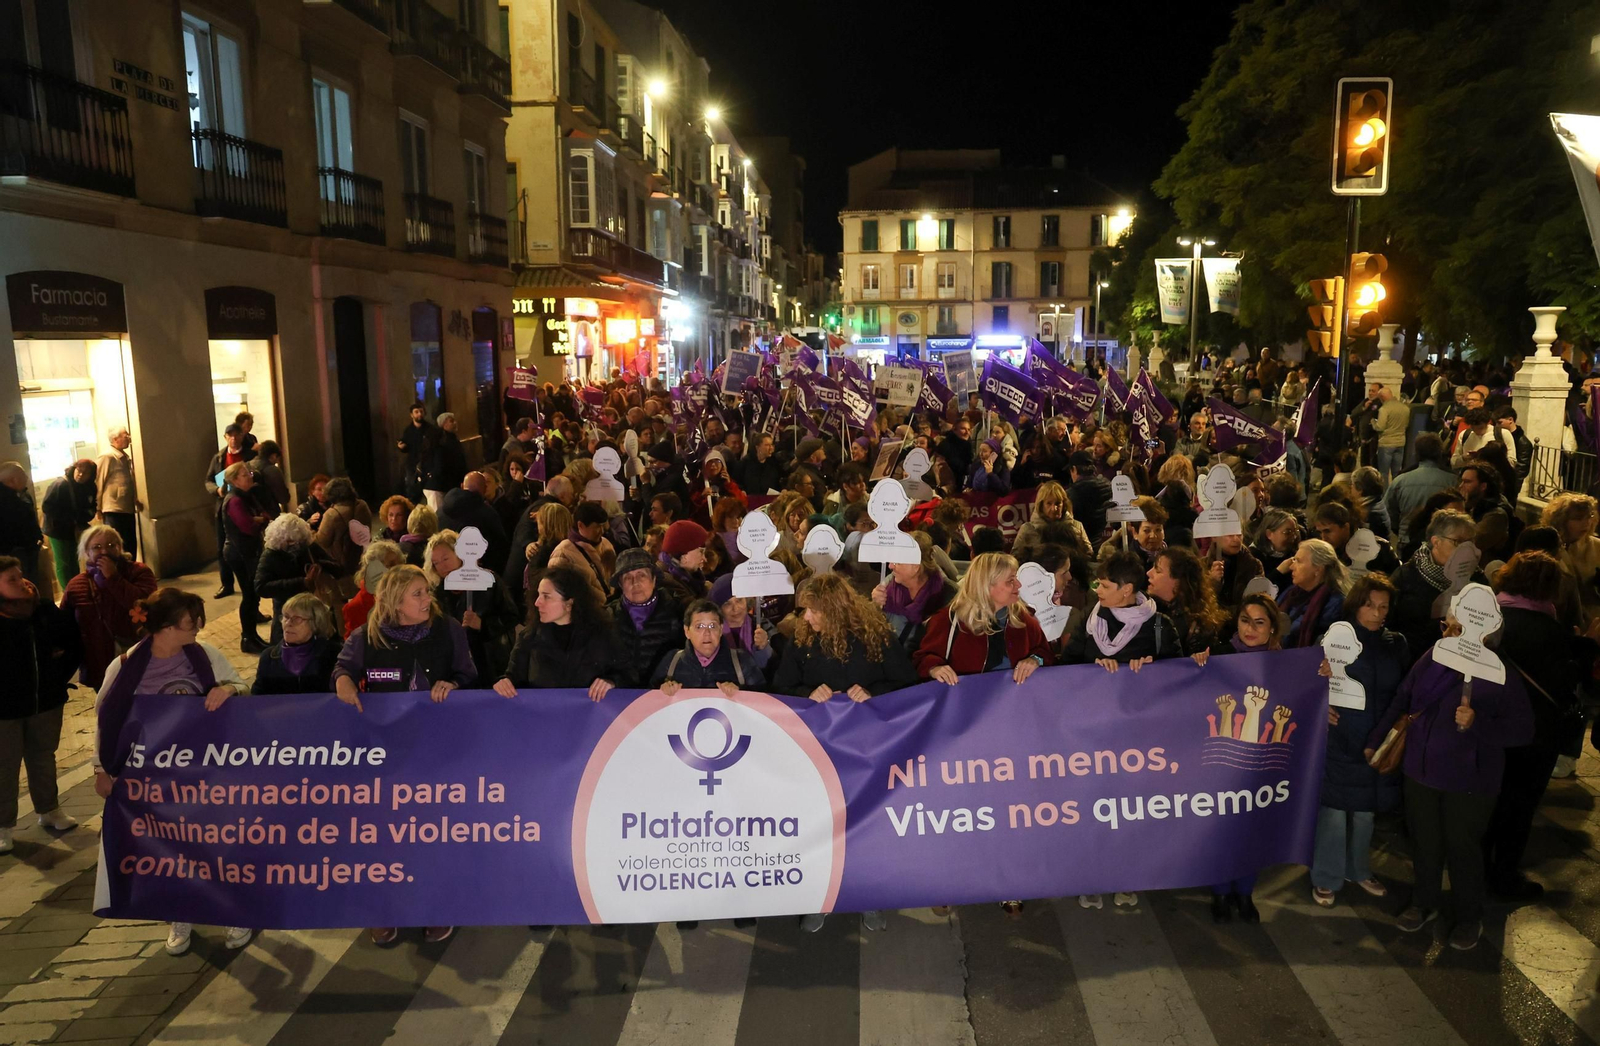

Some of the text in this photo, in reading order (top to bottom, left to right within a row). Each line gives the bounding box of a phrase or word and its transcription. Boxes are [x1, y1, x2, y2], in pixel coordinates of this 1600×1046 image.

[114, 59, 175, 91] PLAZA DE
[111, 77, 180, 111] LA MERCED
[30, 283, 107, 307] Farmacia
[42, 313, 99, 327] Bustamante
[220, 303, 266, 320] Apotheke
[1477, 610, 1494, 619] VARELA
[1330, 643, 1351, 651] MIRIAM
[369, 671, 393, 679] CCOO
[154, 743, 193, 768] de
[202, 740, 387, 767] Noviembre
[887, 747, 1179, 790] Ni una menos,
[171, 777, 382, 805] Internacional
[392, 782, 467, 811] para
[478, 776, 505, 803] la
[884, 780, 1290, 837] Vivas nos queremos
[130, 813, 541, 845] eliminación de la violencia
[621, 810, 799, 839] Plataforma
[666, 838, 750, 854] contra las
[119, 853, 415, 892] contra las mujeres.
[618, 852, 801, 870] violencias machistas
[617, 867, 803, 892] VIOLENCIA CERO
